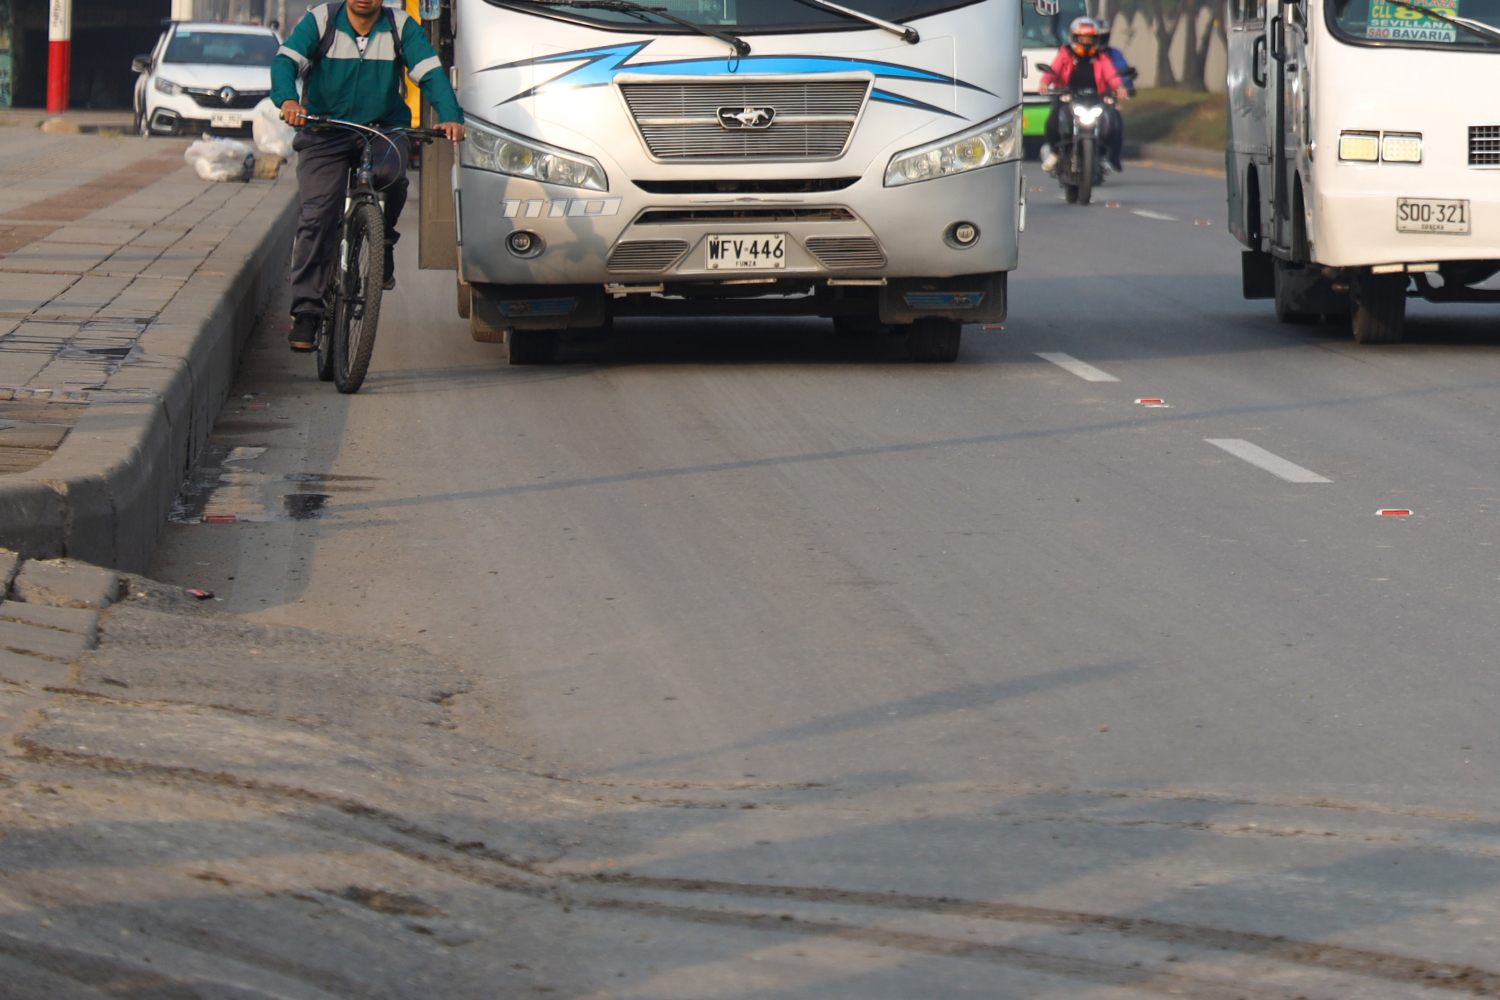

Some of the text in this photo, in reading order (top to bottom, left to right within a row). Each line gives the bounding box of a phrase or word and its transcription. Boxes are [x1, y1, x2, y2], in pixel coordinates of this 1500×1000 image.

[1372, 6, 1392, 18] CLL
[1371, 19, 1453, 29] SEVILLANA
[1369, 28, 1452, 41] SAO BAVARIA
[501, 197, 623, 218] 1110
